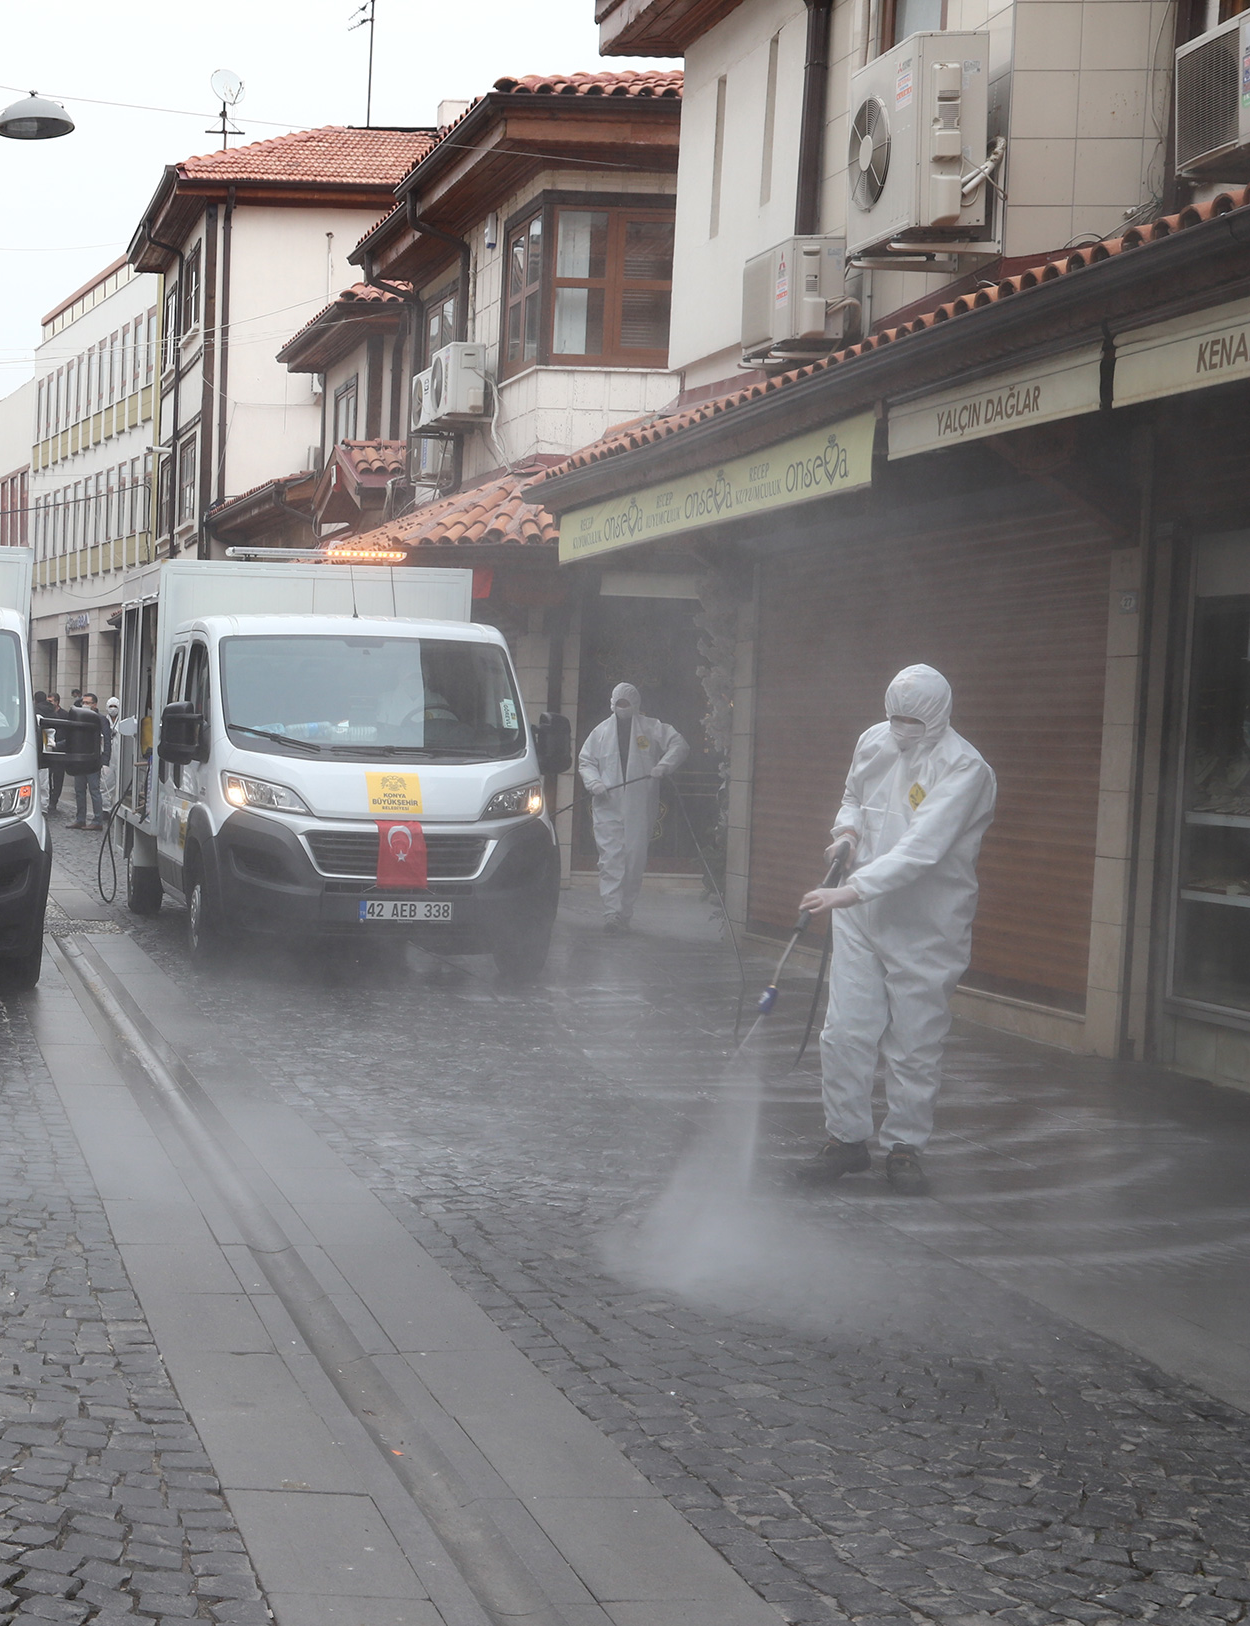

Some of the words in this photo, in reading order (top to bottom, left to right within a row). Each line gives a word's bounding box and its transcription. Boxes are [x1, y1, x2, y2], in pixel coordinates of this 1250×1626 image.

[937, 401, 981, 436] YALÇIN
[984, 385, 1041, 424] DAĞLAR
[749, 462, 770, 482] RECEP
[735, 478, 782, 504] KUYUMCULUK
[372, 797, 418, 806] BÜYÜKŞEHİR
[367, 903, 384, 917] 42
[391, 903, 417, 918] AEB
[424, 904, 450, 918] 338
